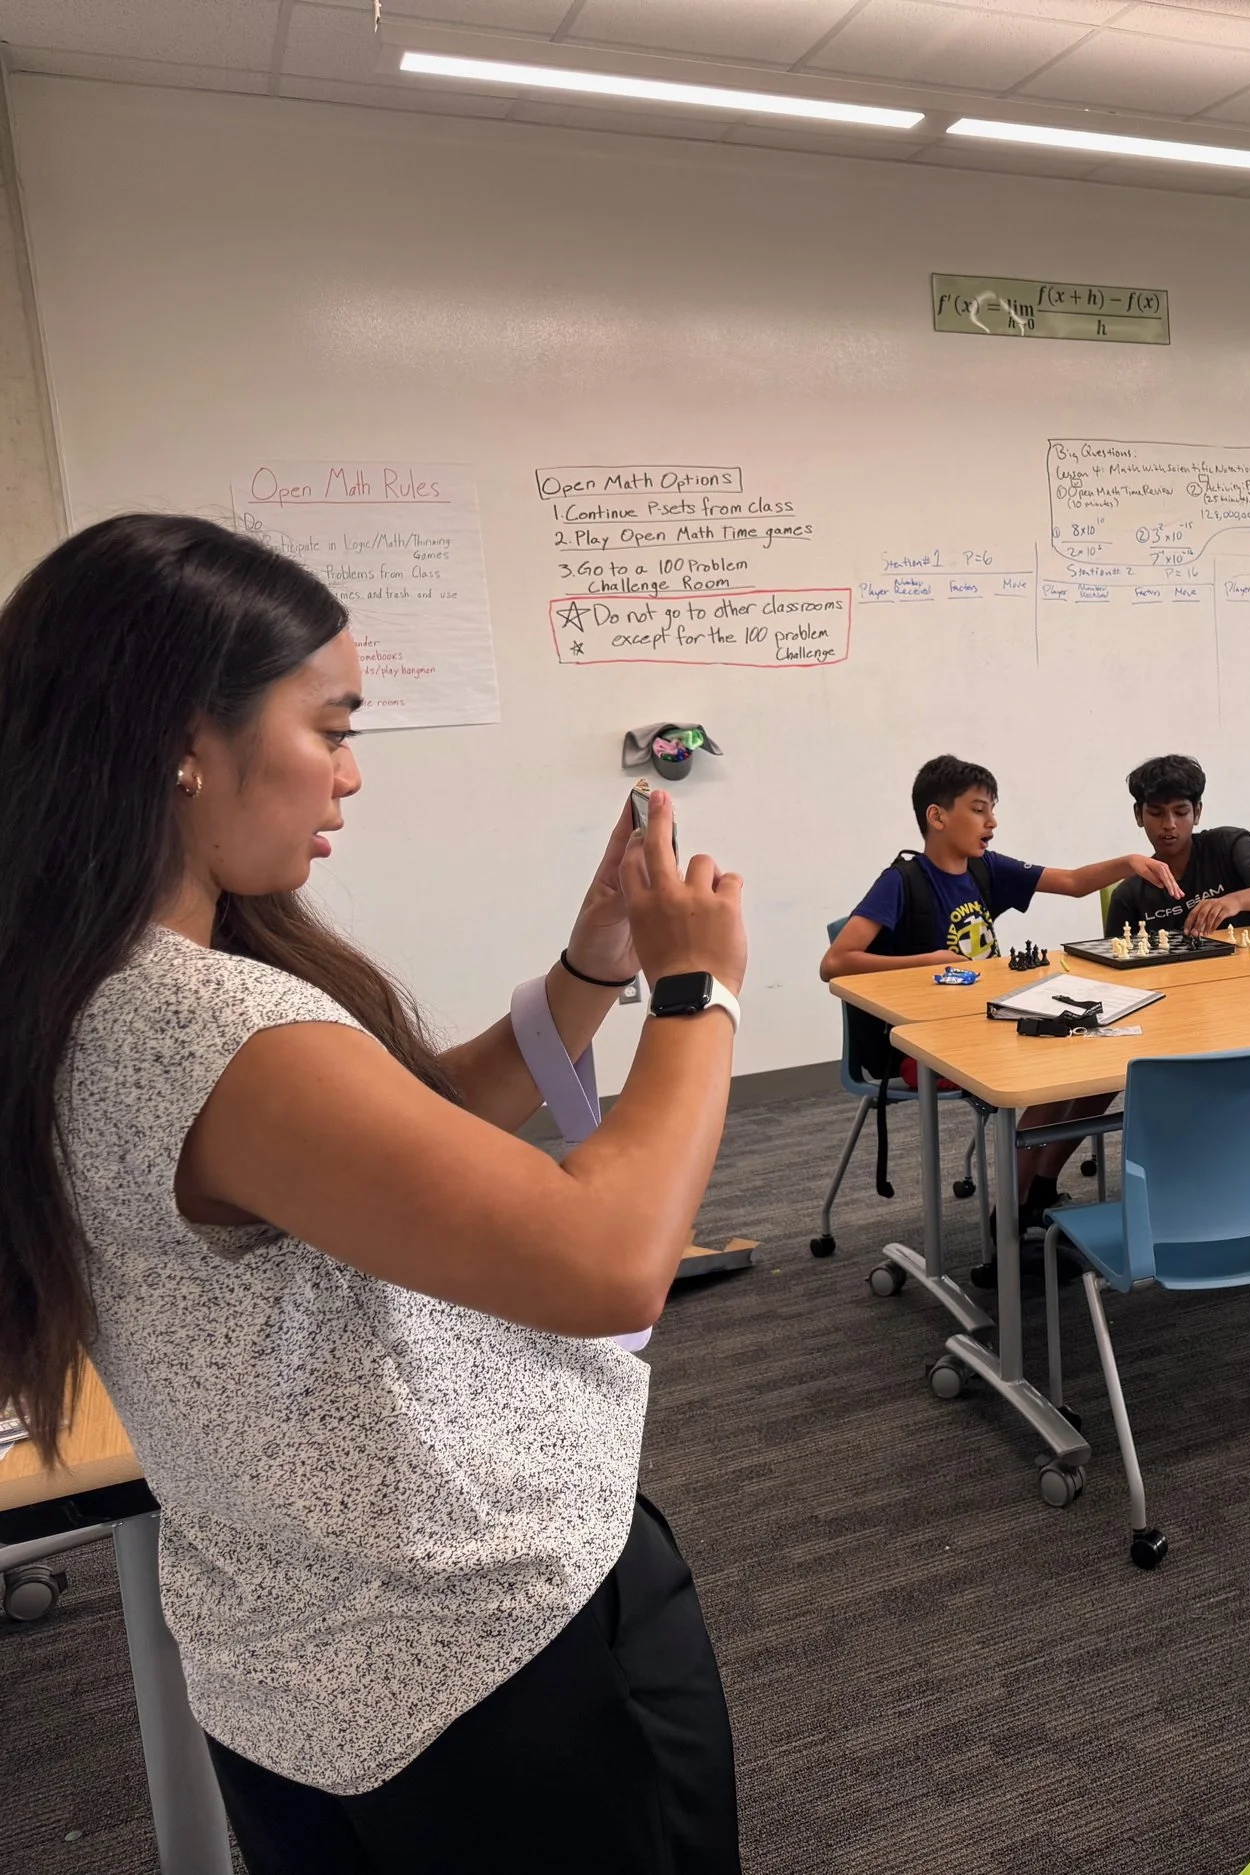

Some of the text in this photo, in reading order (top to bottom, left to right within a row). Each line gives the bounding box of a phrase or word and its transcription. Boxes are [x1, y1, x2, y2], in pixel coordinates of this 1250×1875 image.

[1053, 443, 1079, 463] Big
[1056, 465, 1089, 480] Lesson
[1109, 464, 1140, 475] Math
[1168, 461, 1214, 473] Scientific
[251, 467, 440, 508] Open Math Rules
[541, 472, 733, 498] Open Math Options
[1068, 486, 1094, 499] Open
[1097, 486, 1120, 497] Math
[1143, 485, 1174, 495] Review
[565, 504, 638, 521] Continue
[648, 499, 696, 515] P-sets
[701, 496, 742, 516] from
[748, 497, 794, 513] class
[1085, 498, 1119, 509] minutes)
[244, 512, 263, 530] Do
[329, 542, 337, 551] in
[575, 529, 609, 551] Play
[621, 528, 666, 547] Open
[677, 526, 714, 541] Math
[722, 526, 757, 539] Time
[763, 524, 813, 549] games
[413, 550, 450, 560] Games
[326, 564, 375, 580] Problems
[380, 563, 404, 579] from
[411, 565, 441, 579] Class
[610, 560, 628, 575] to
[635, 565, 648, 575] a
[659, 558, 685, 574] 100
[688, 558, 748, 573] Problem
[367, 588, 382, 599] and
[386, 587, 410, 599] trash
[417, 588, 432, 599] and
[588, 575, 730, 598] Challenge Room
[859, 582, 889, 598] Player
[949, 580, 978, 593] Factors
[1003, 578, 1027, 589] Move
[1042, 585, 1069, 598] Player
[1175, 588, 1197, 596] Move
[593, 594, 844, 629] Do not go to other classrooms
[611, 624, 830, 650] except for the 100 problem
[775, 646, 836, 663] Challenge
[1185, 884, 1225, 909] BEAM
